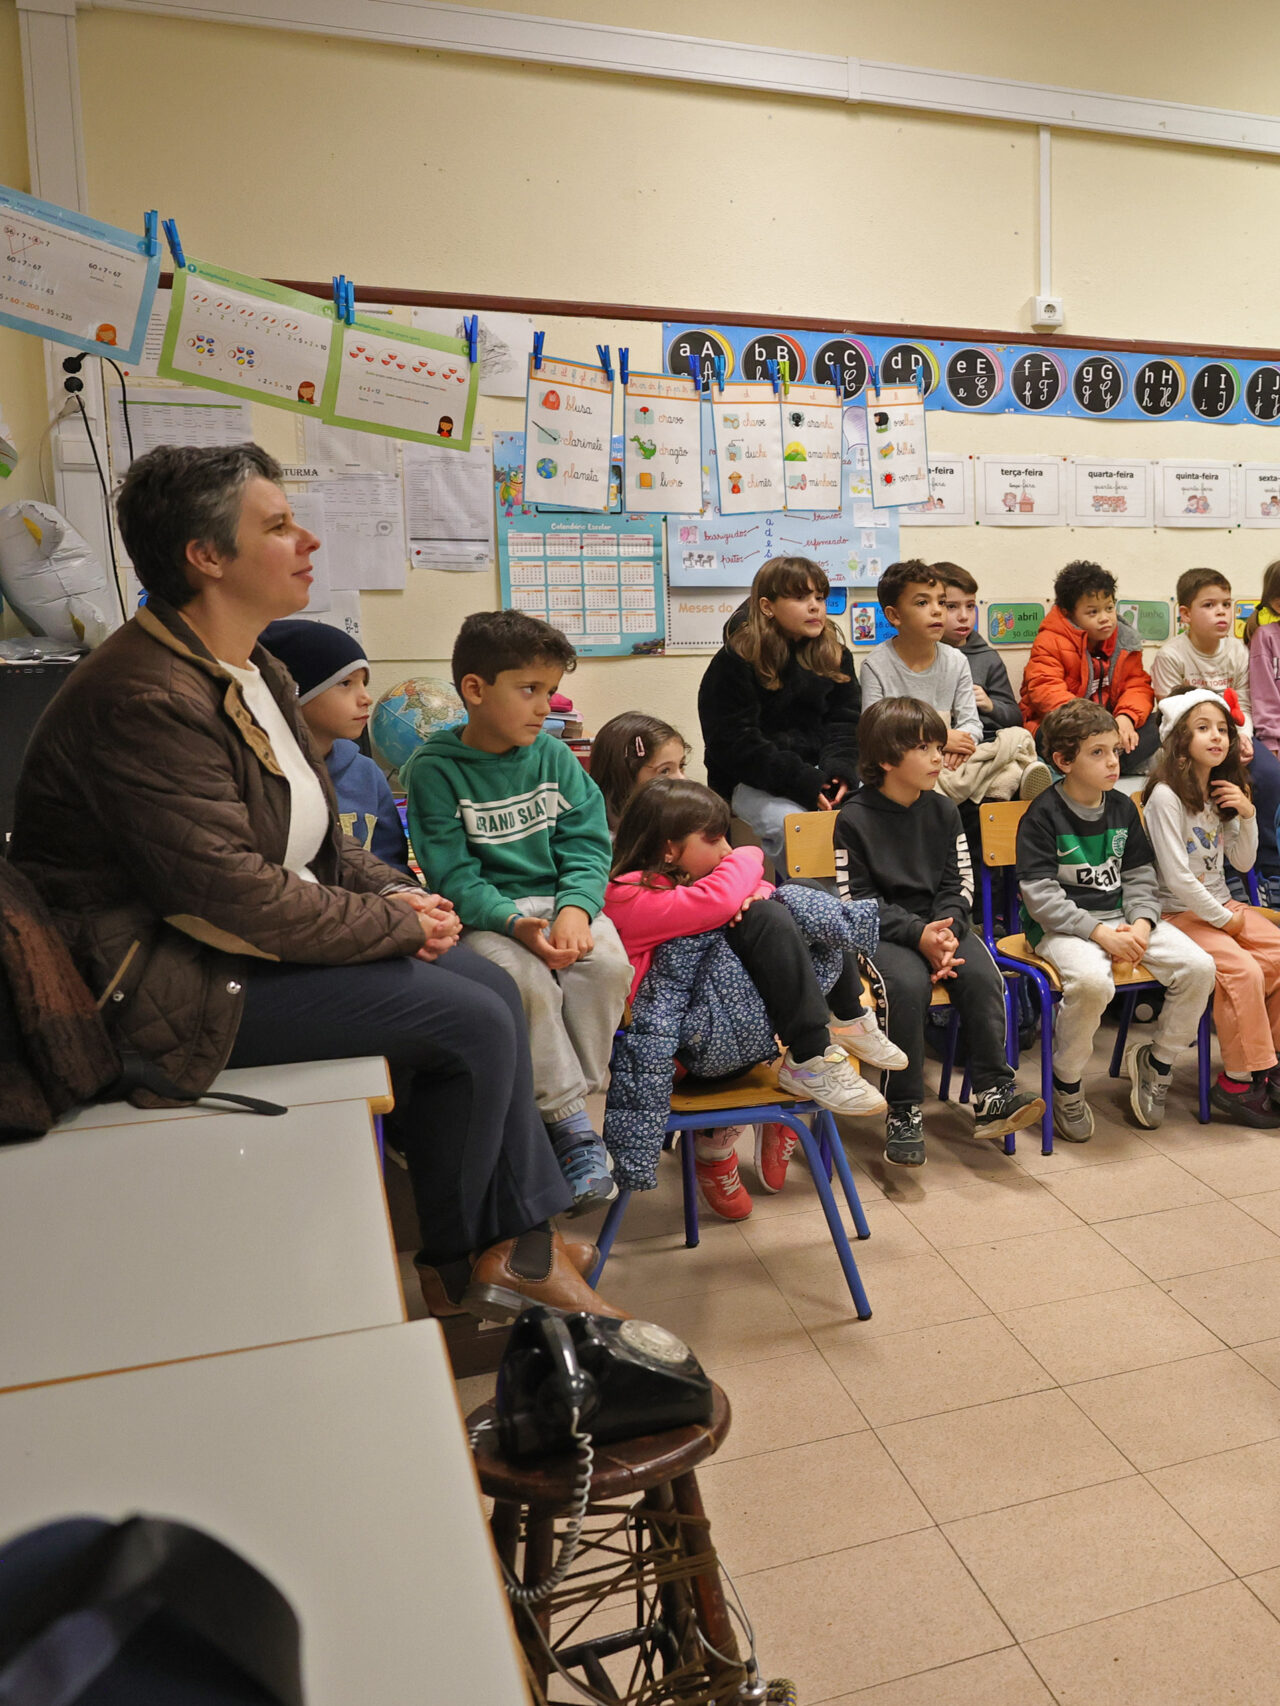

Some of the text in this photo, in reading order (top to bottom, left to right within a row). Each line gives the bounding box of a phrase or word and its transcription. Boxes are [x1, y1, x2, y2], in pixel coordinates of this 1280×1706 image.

[680, 341, 715, 358] a A
[755, 343, 789, 362] b B
[825, 350, 856, 366] c C
[892, 352, 901, 369] d
[957, 359, 986, 374] e E
[1024, 360, 1053, 376] f F
[1083, 365, 1112, 382] g G
[1145, 368, 1172, 384] h H
[1204, 373, 1226, 388] i I
[1256, 375, 1279, 392] j J
[562, 431, 603, 451] clarinete
[283, 468, 319, 477] TURMA
[562, 463, 599, 486] planeta
[1001, 468, 1043, 477] terça-feira
[1088, 470, 1134, 480] quarta-feira
[1175, 472, 1219, 481] quinta-feira
[678, 602, 714, 613] Meses
[1018, 612, 1038, 621] abril
